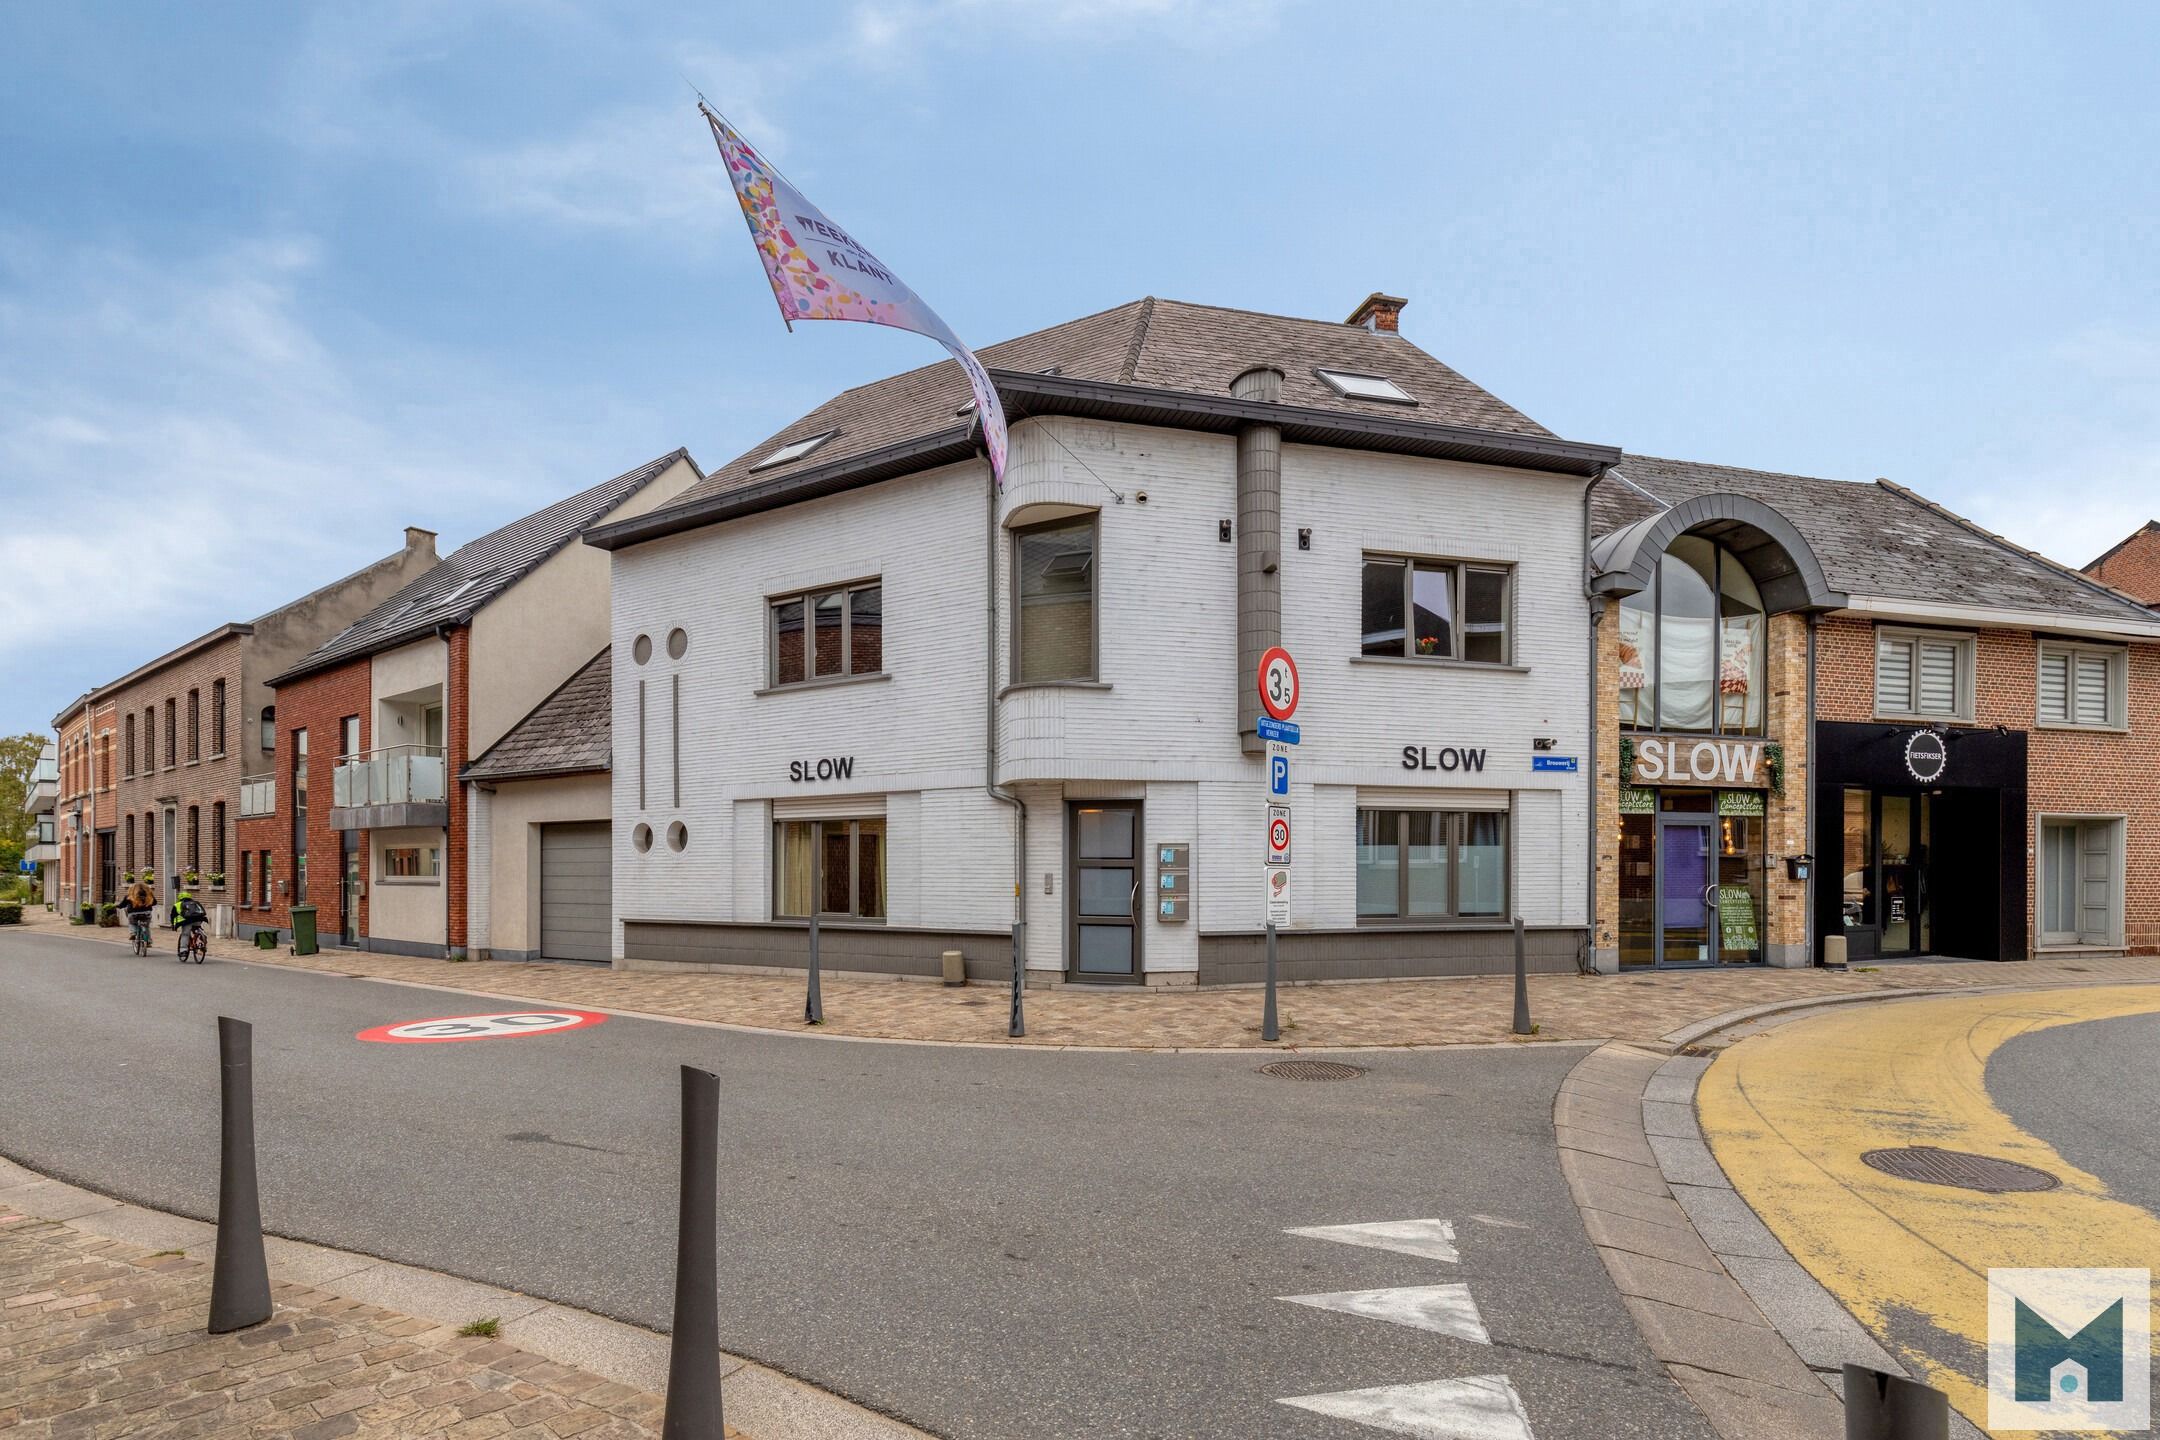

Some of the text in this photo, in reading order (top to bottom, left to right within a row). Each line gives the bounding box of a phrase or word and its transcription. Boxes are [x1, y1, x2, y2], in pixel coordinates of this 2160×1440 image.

[826, 250, 894, 286] KLANT
[1272, 743, 1288, 753] ZONE
[1402, 745, 1486, 772] SLOW
[1637, 739, 1760, 783] SLOW
[1910, 751, 1942, 760] FIETSFIKSER
[789, 756, 854, 782] SLOW
[1726, 792, 1750, 804] SLOW
[1621, 800, 1654, 809] ceptstore
[1273, 809, 1287, 817] ZONE
[1274, 829, 1285, 841] 30
[1719, 888, 1742, 900] SLOW
[403, 1014, 570, 1037] 30
